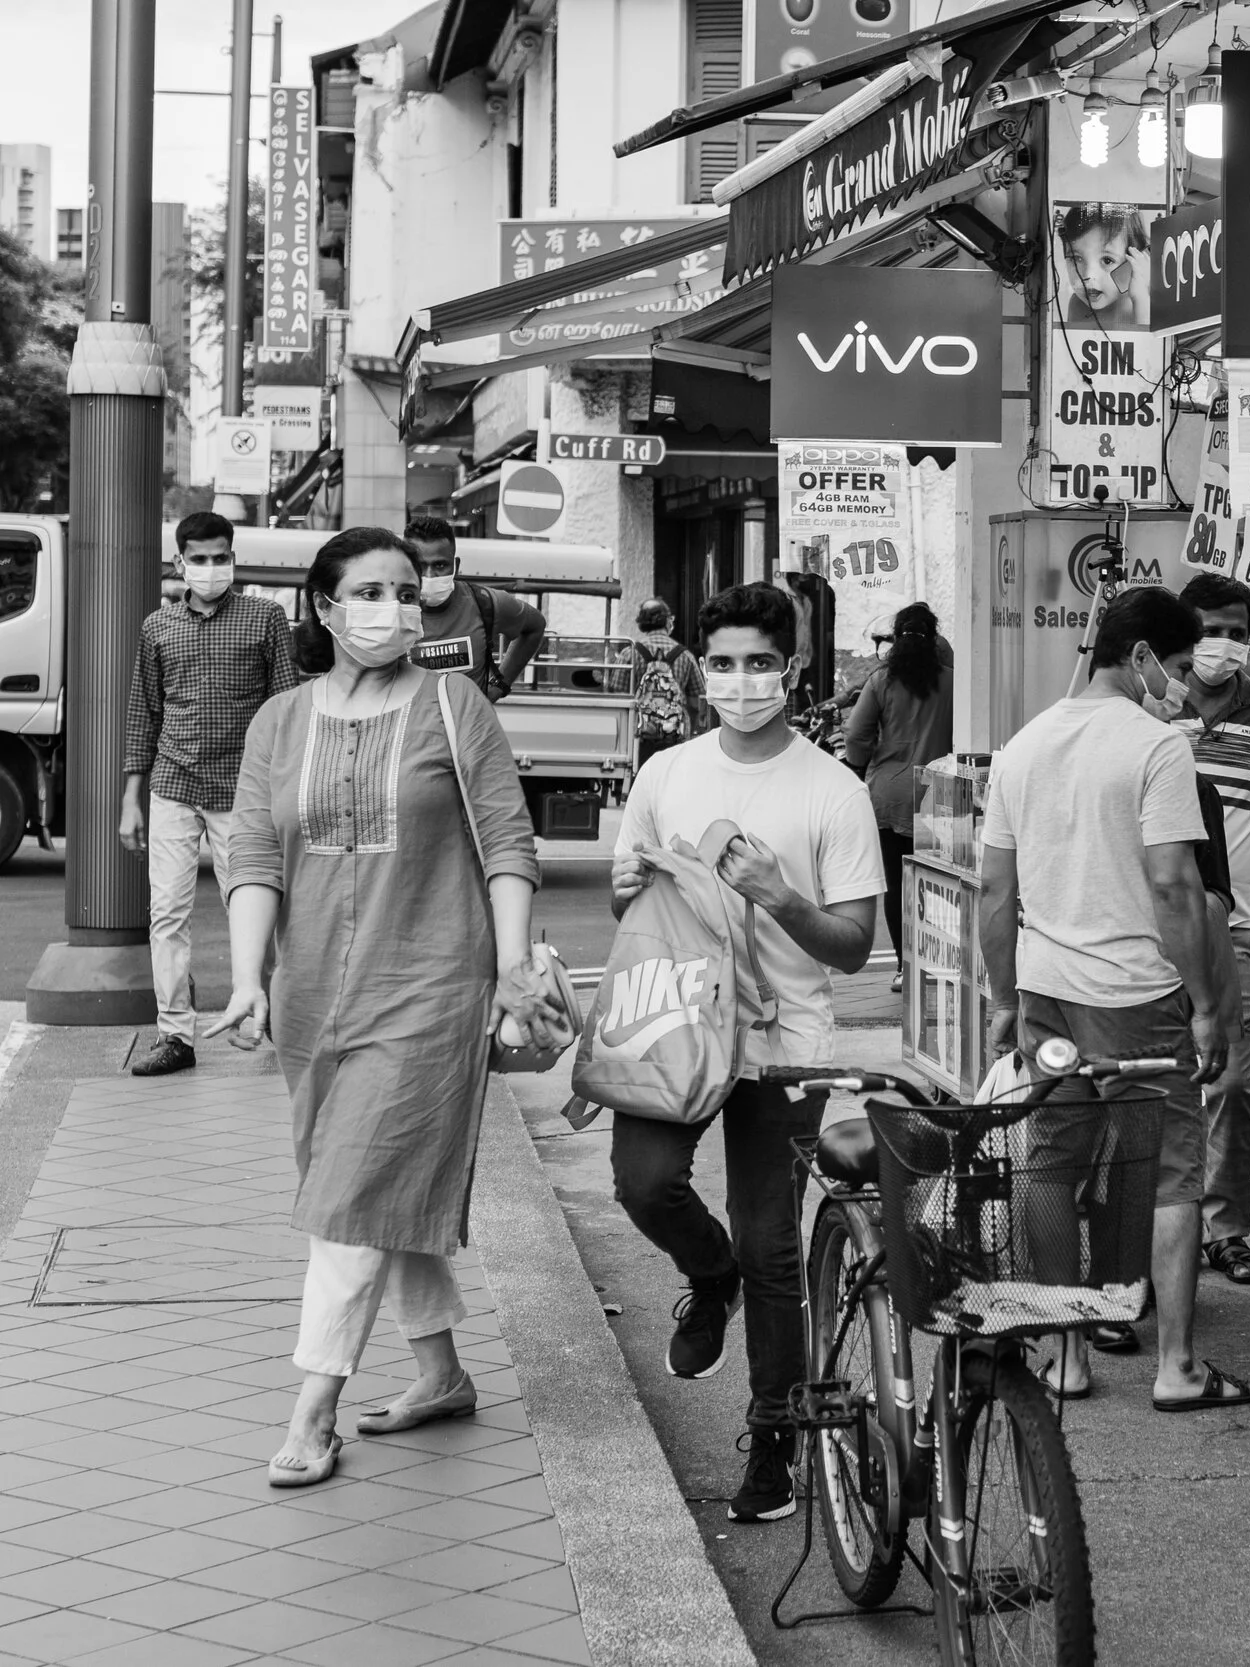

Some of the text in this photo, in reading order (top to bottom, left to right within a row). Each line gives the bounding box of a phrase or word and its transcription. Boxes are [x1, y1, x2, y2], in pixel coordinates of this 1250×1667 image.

[790, 28, 810, 36] Coral
[825, 118, 897, 220] Grand
[290, 90, 310, 333] SELVASEGARA
[280, 336, 296, 346] 114
[797, 320, 978, 375] vivo
[1081, 340, 1134, 375] SIM
[262, 405, 312, 415] PEDESTRIANS
[1060, 390, 1155, 427] CARDS
[279, 419, 312, 428] Crossing
[555, 436, 651, 461] Cuff Rd
[1098, 433, 1115, 457] &
[804, 448, 880, 464] oppo
[799, 471, 887, 491] OFFER
[816, 491, 870, 503] 4GB RAM
[799, 502, 887, 514] 64GB MEMORY
[786, 518, 812, 527] FREE
[813, 518, 847, 527] COVER
[850, 519, 858, 528] &
[832, 537, 900, 580] $179
[1130, 576, 1163, 585] mobiles
[1034, 606, 1090, 628] Sales
[420, 643, 459, 658] POSITIVE
[604, 957, 708, 1033] NIKE
